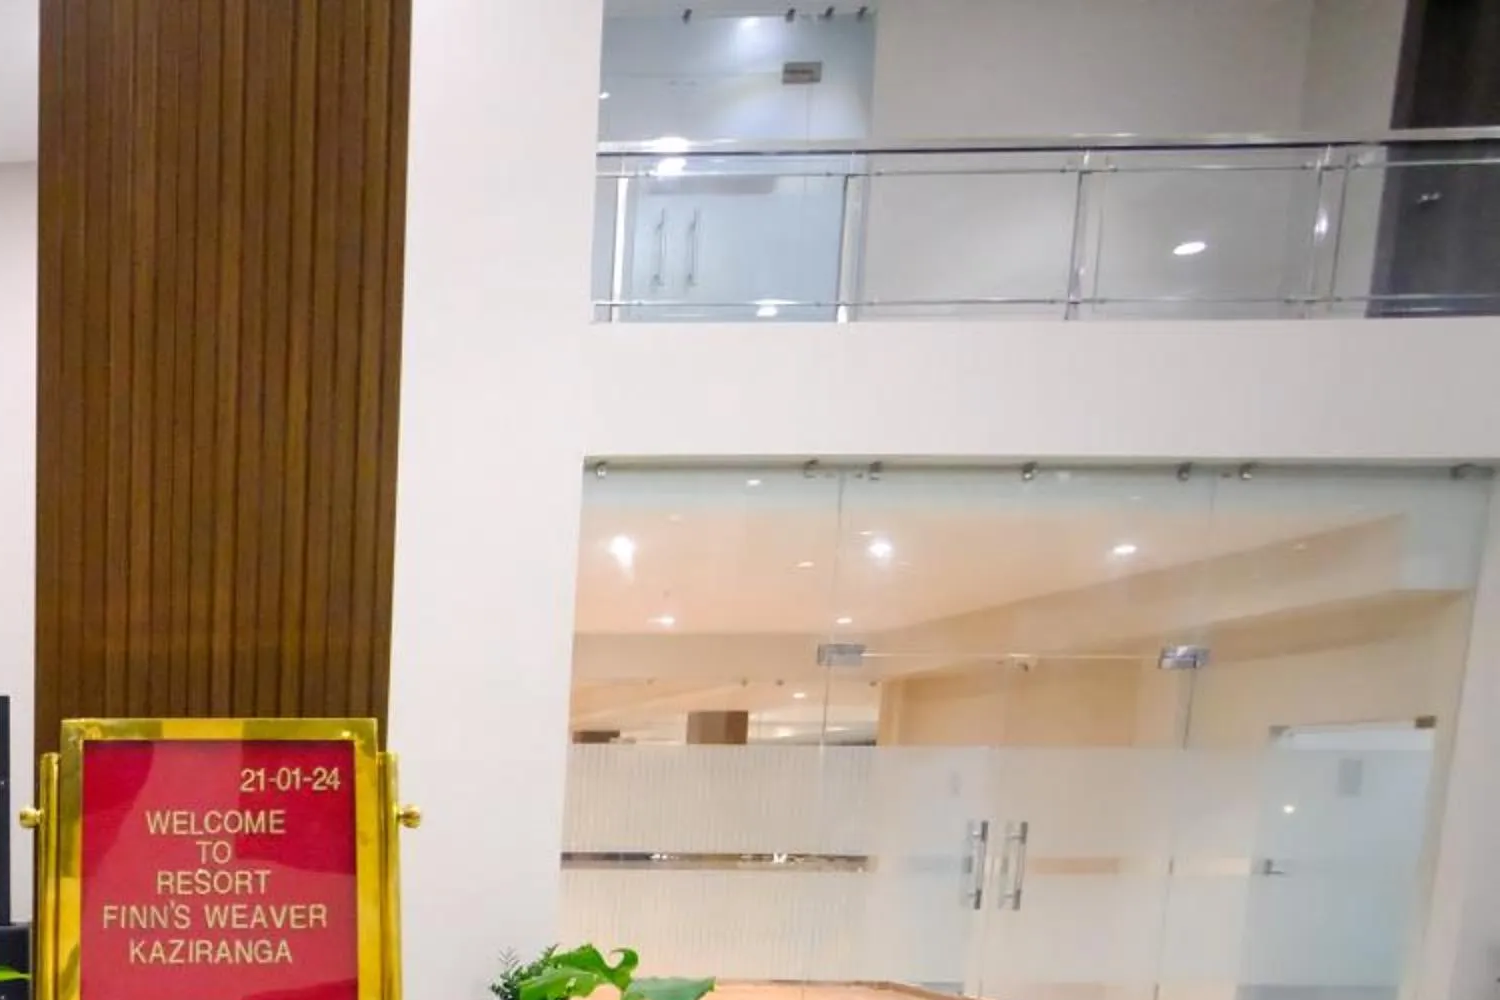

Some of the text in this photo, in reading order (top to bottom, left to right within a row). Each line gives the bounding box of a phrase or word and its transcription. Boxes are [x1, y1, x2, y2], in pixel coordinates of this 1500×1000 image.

[240, 767, 341, 792] 21-01-24
[146, 810, 286, 835] WELCOME
[196, 840, 232, 864] TO
[157, 869, 271, 895] RESORT
[102, 900, 327, 929] FINN'S WEAVER
[128, 939, 293, 965] KAZIRANGA
